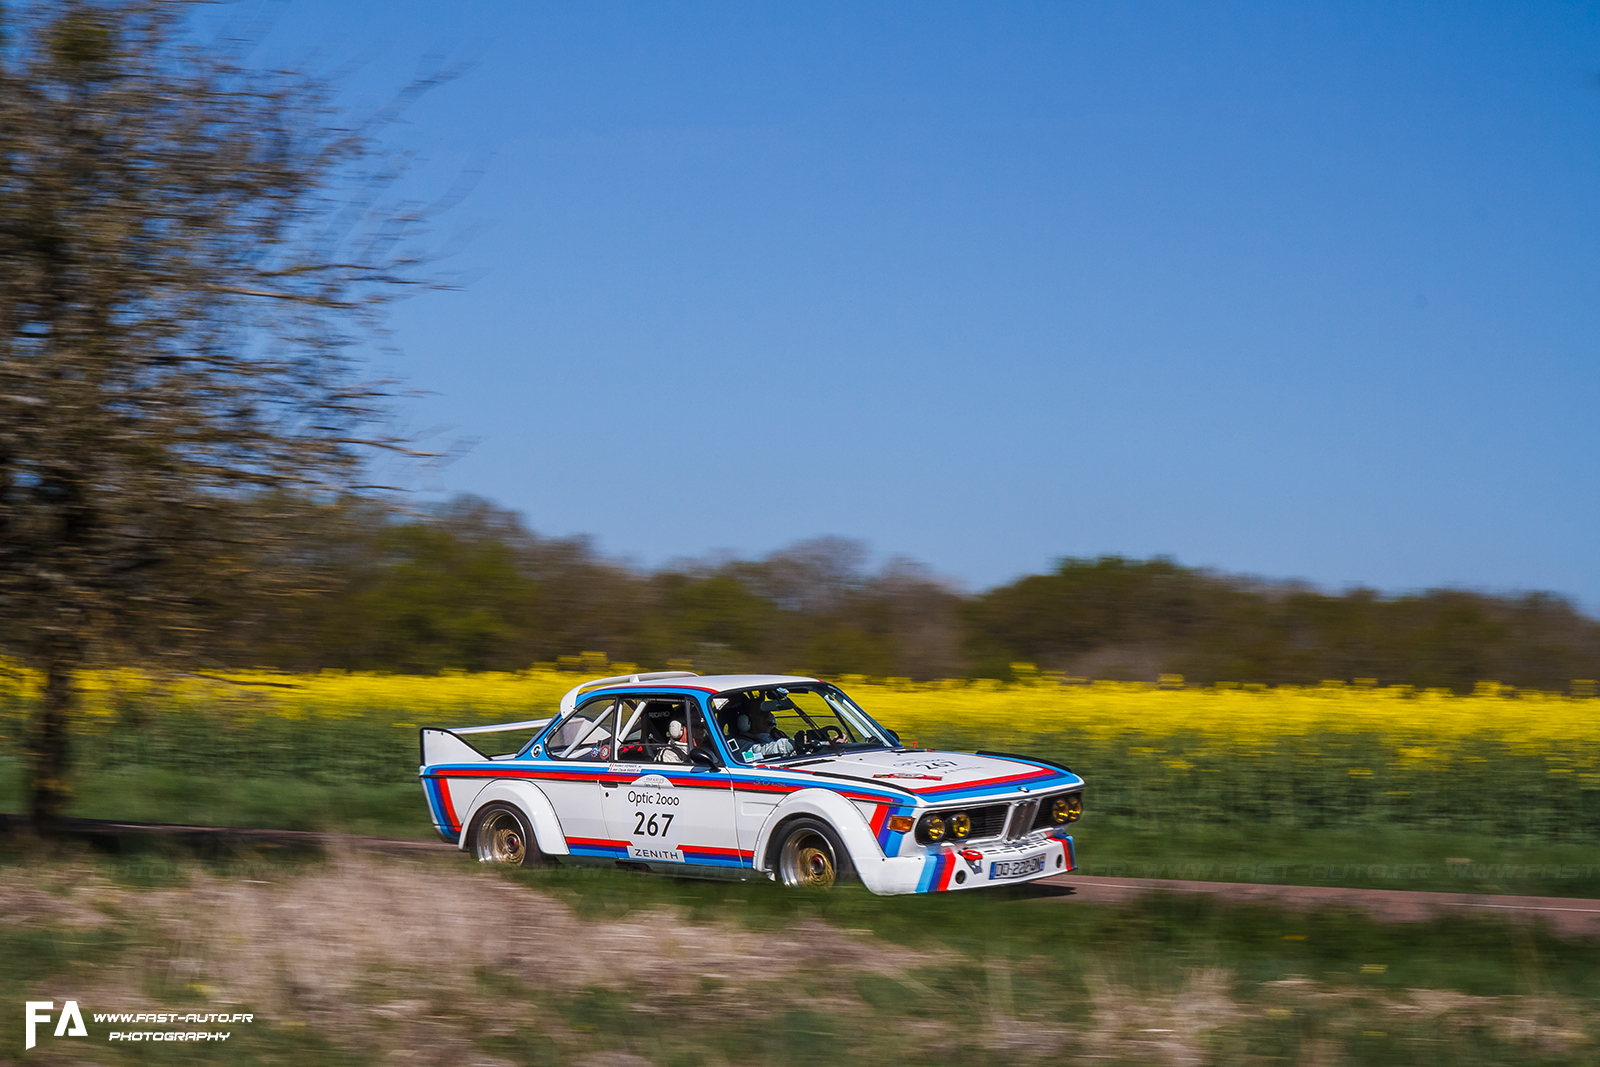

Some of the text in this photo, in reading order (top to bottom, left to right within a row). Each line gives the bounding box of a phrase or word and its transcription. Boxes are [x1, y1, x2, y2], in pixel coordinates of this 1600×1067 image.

[627, 790, 680, 807] Optic 2000
[633, 811, 675, 838] 267
[634, 848, 679, 860] ZENITH
